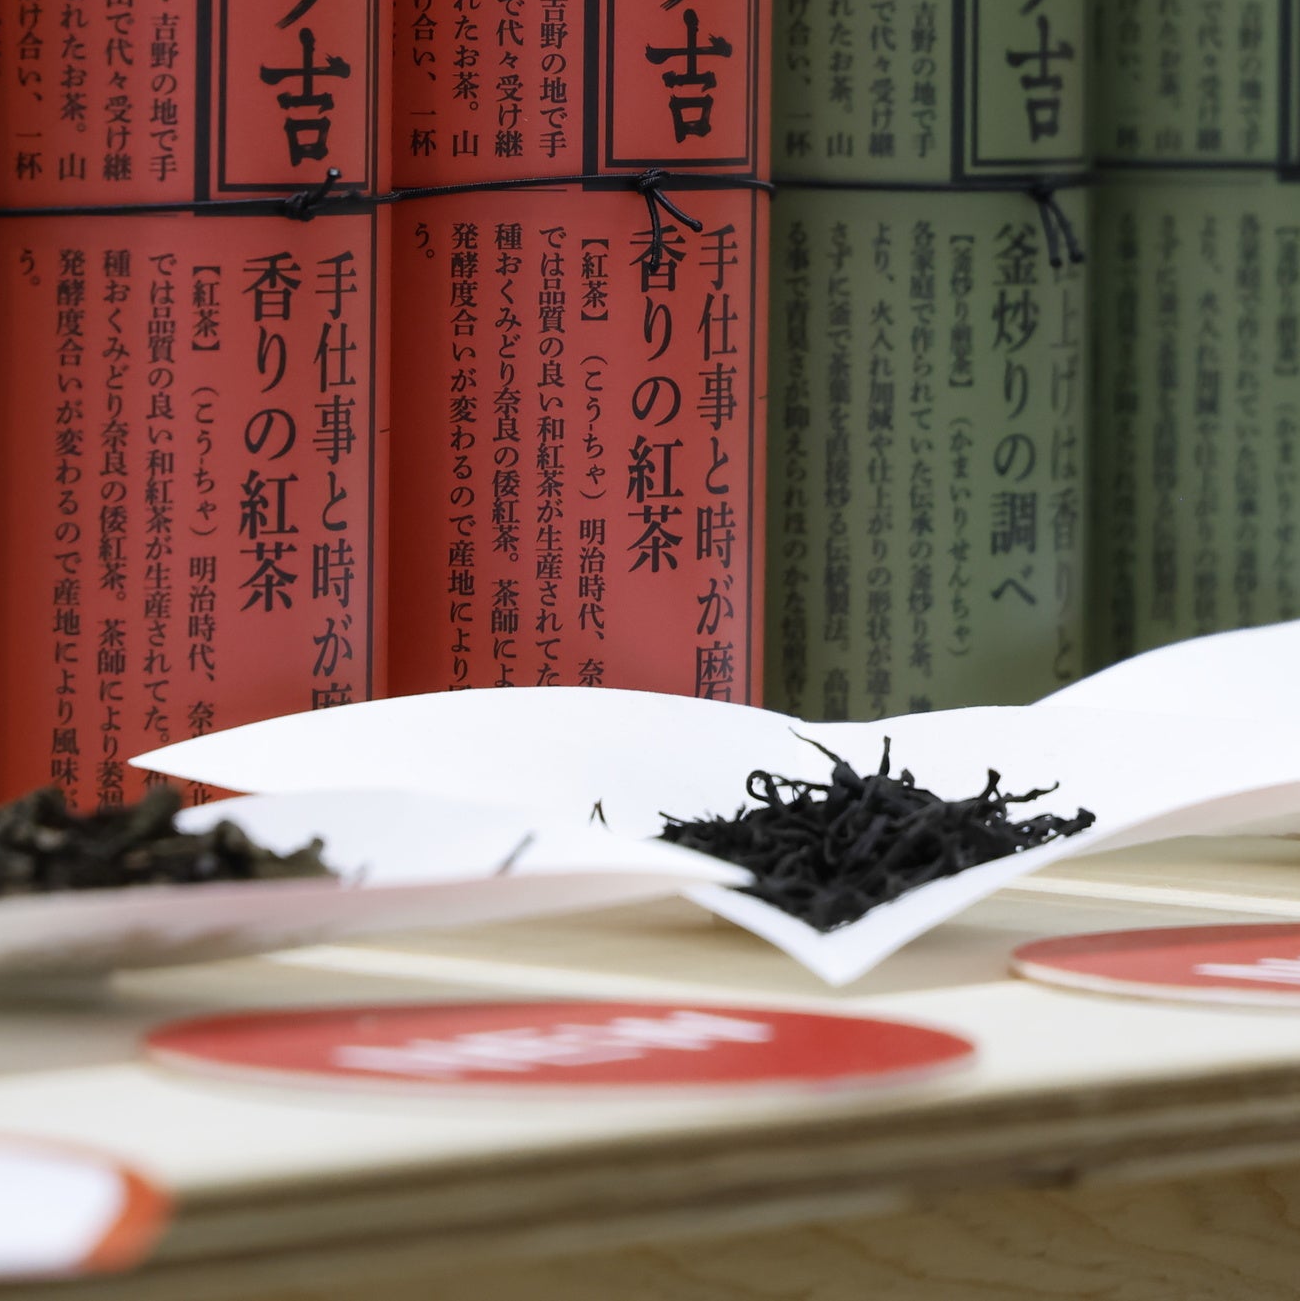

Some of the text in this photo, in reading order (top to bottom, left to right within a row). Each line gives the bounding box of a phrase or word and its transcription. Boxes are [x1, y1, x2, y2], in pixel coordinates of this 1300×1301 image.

[20, 250, 41, 286] う。
[237, 251, 302, 613] 香りの紅茶
[414, 222, 435, 260] う。
[626, 225, 687, 573] 香りの紅茶
[990, 223, 1041, 605] 釜炒りの調べ
[448, 223, 479, 690] 発酵度合いが変わるので産地により
[536, 226, 565, 686] では品質の良い和紅茶が生産されてた
[695, 223, 738, 708] 手仕事と時が磨
[1049, 262, 1080, 680] 上げは香りと
